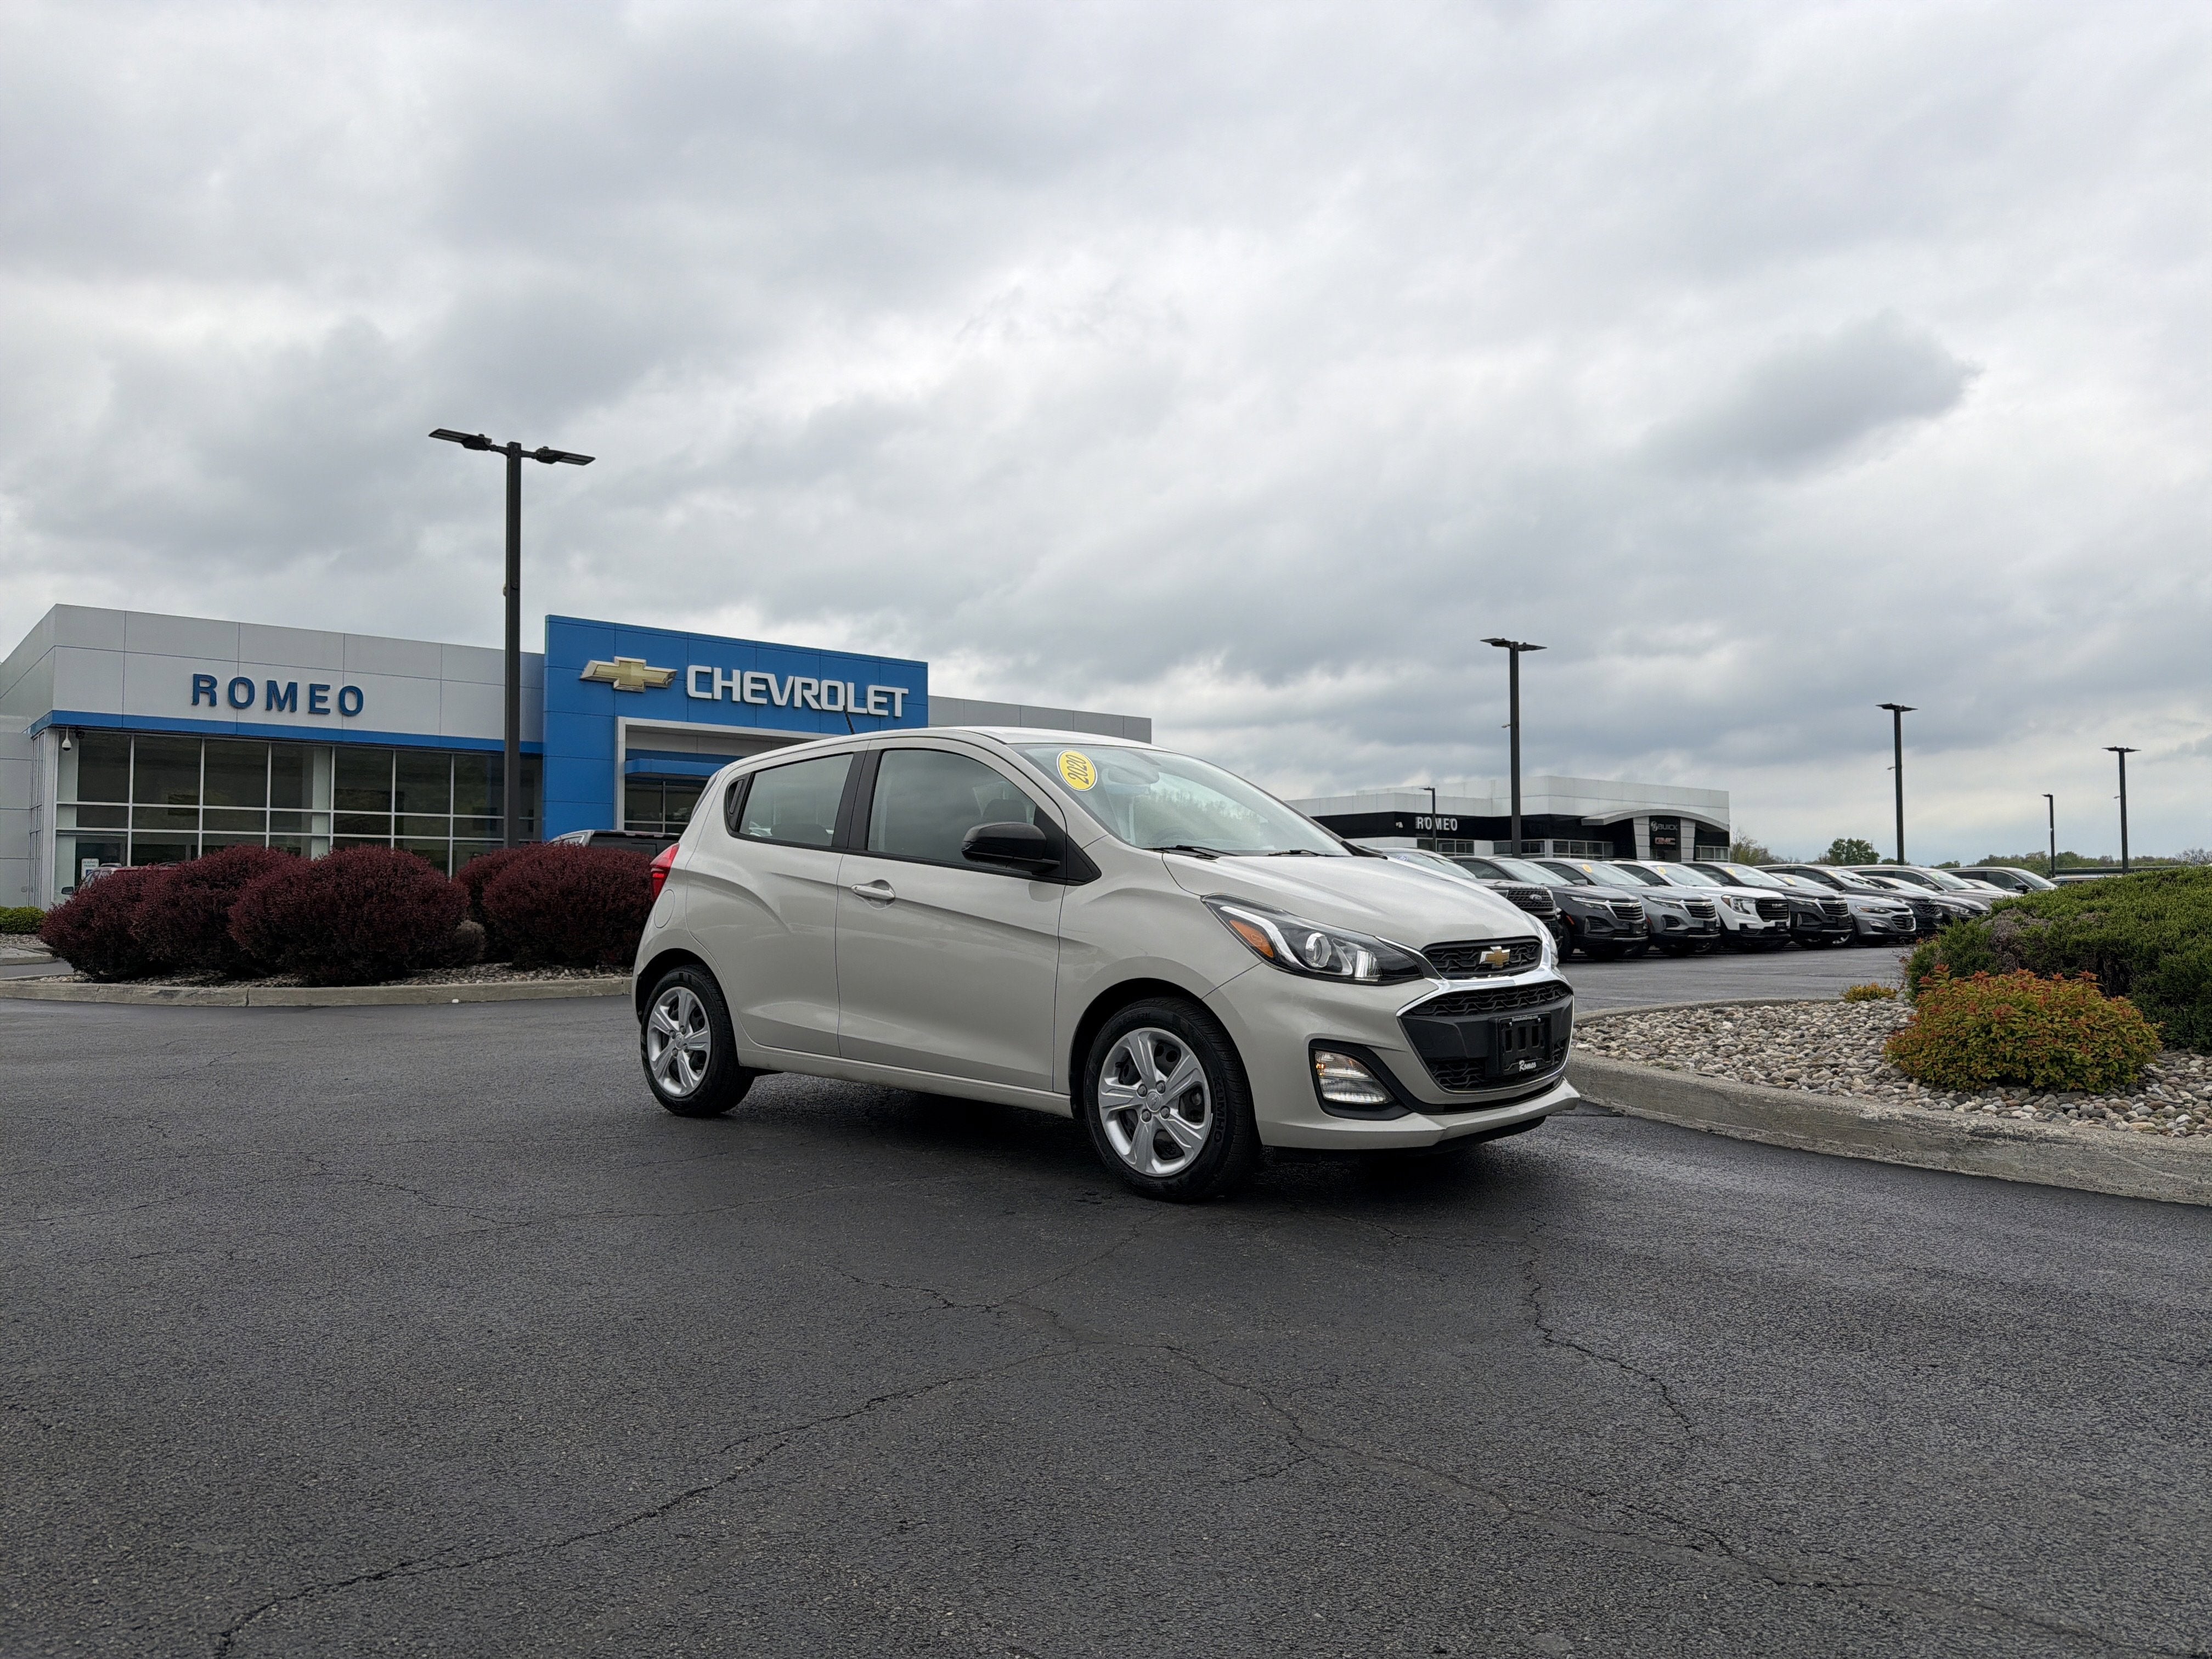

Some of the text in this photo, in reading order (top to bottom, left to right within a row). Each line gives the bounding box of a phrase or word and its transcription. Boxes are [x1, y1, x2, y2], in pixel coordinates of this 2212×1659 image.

[191, 674, 364, 716] ROMEO
[687, 665, 909, 717] CHEVROLET
[1065, 754, 1089, 785] 2020
[1415, 816, 1458, 831] ROMEO
[1655, 837, 1676, 845] GMC
[1519, 1060, 1536, 1071] Romeo
[1212, 1076, 1224, 1143] KUMHO
